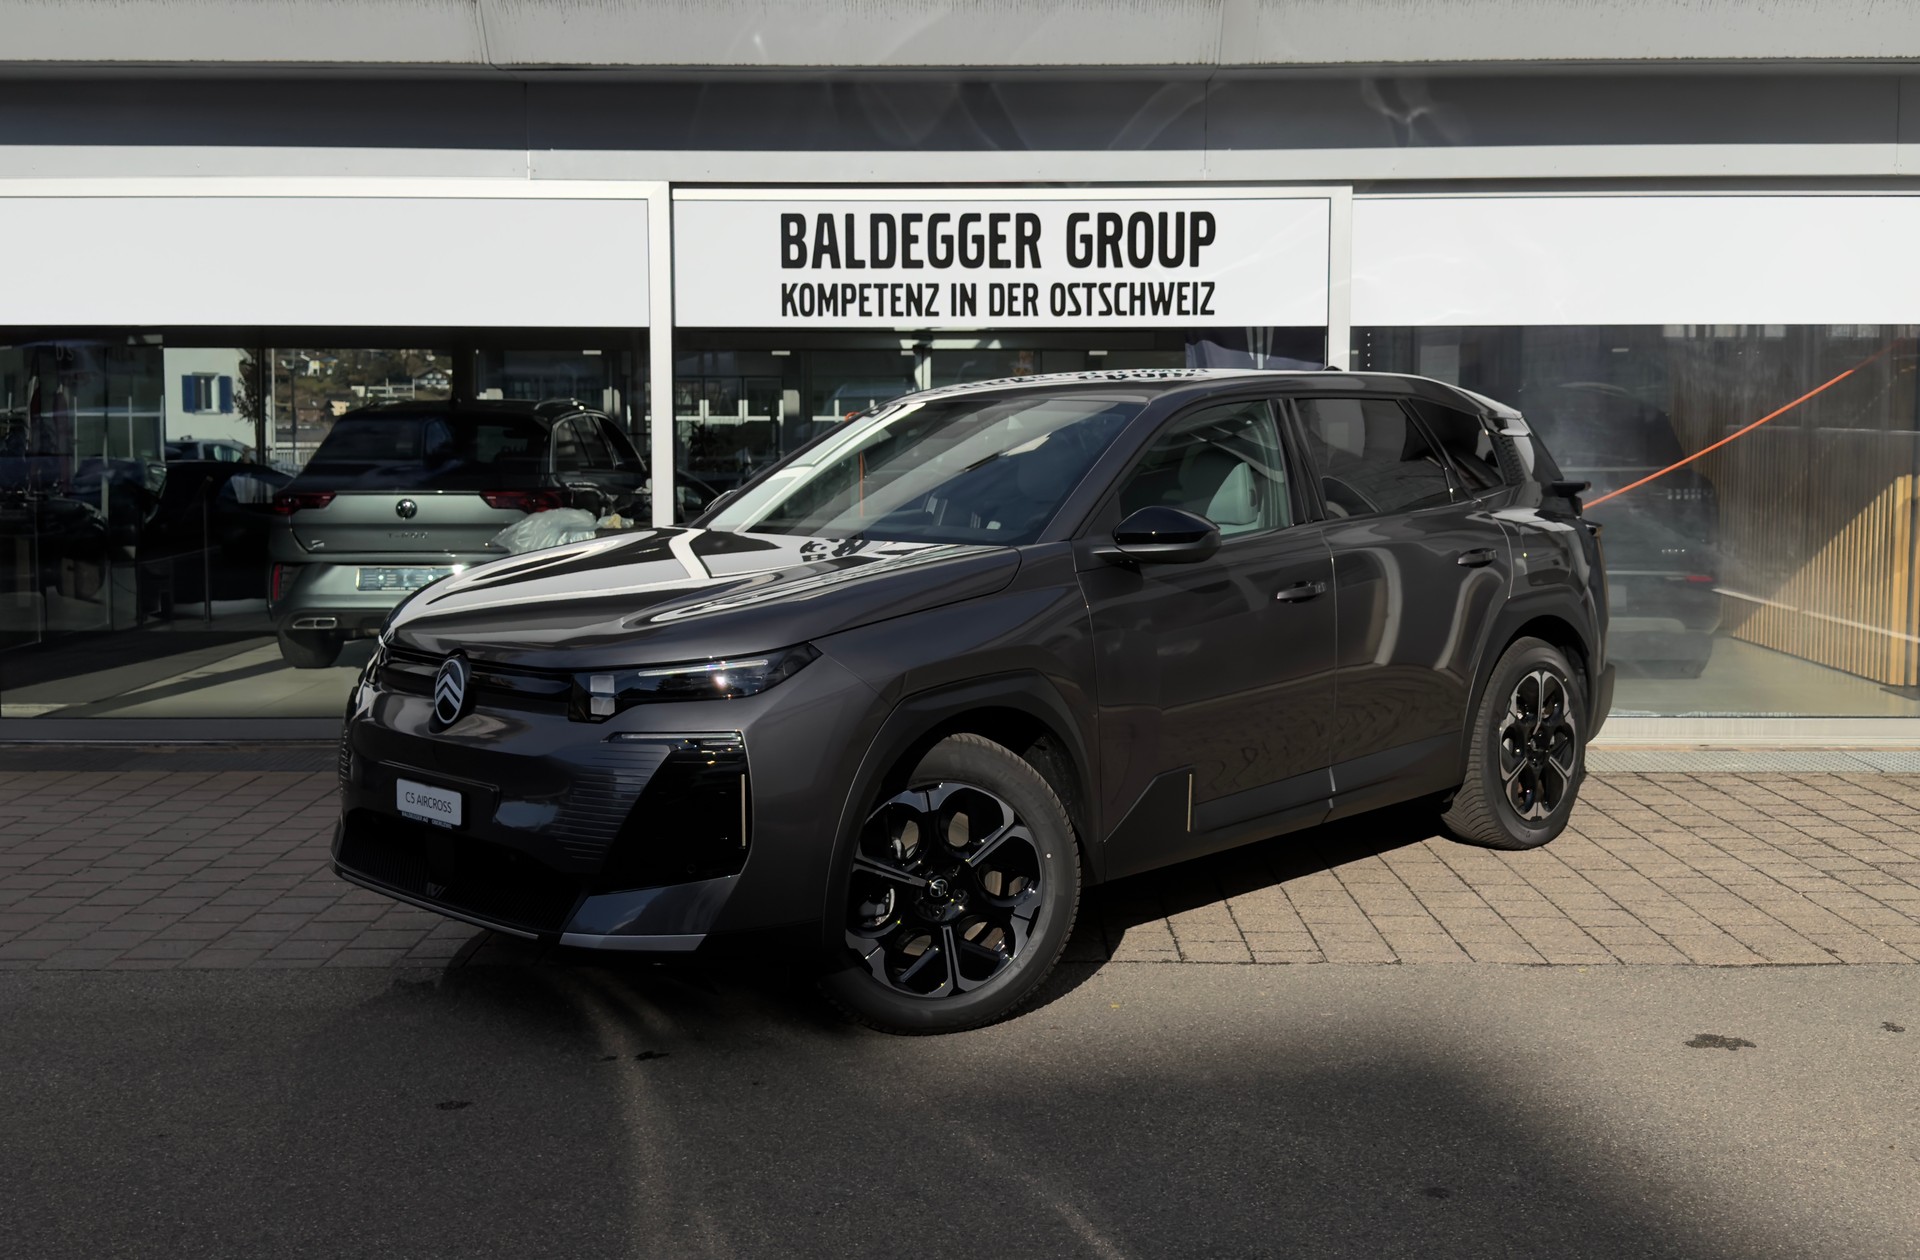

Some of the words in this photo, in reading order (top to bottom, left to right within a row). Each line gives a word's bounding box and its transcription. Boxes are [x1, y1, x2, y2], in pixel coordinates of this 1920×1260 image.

[781, 213, 1041, 269] BALDEGGER
[1066, 211, 1216, 268] GROUP
[782, 283, 939, 317] KOMPETENZ
[951, 283, 976, 316] IN
[989, 283, 1038, 316] DER
[1050, 282, 1215, 317] OSTSCHWEIZ
[406, 791, 415, 804] C5
[416, 794, 452, 813] AIRCROSS
